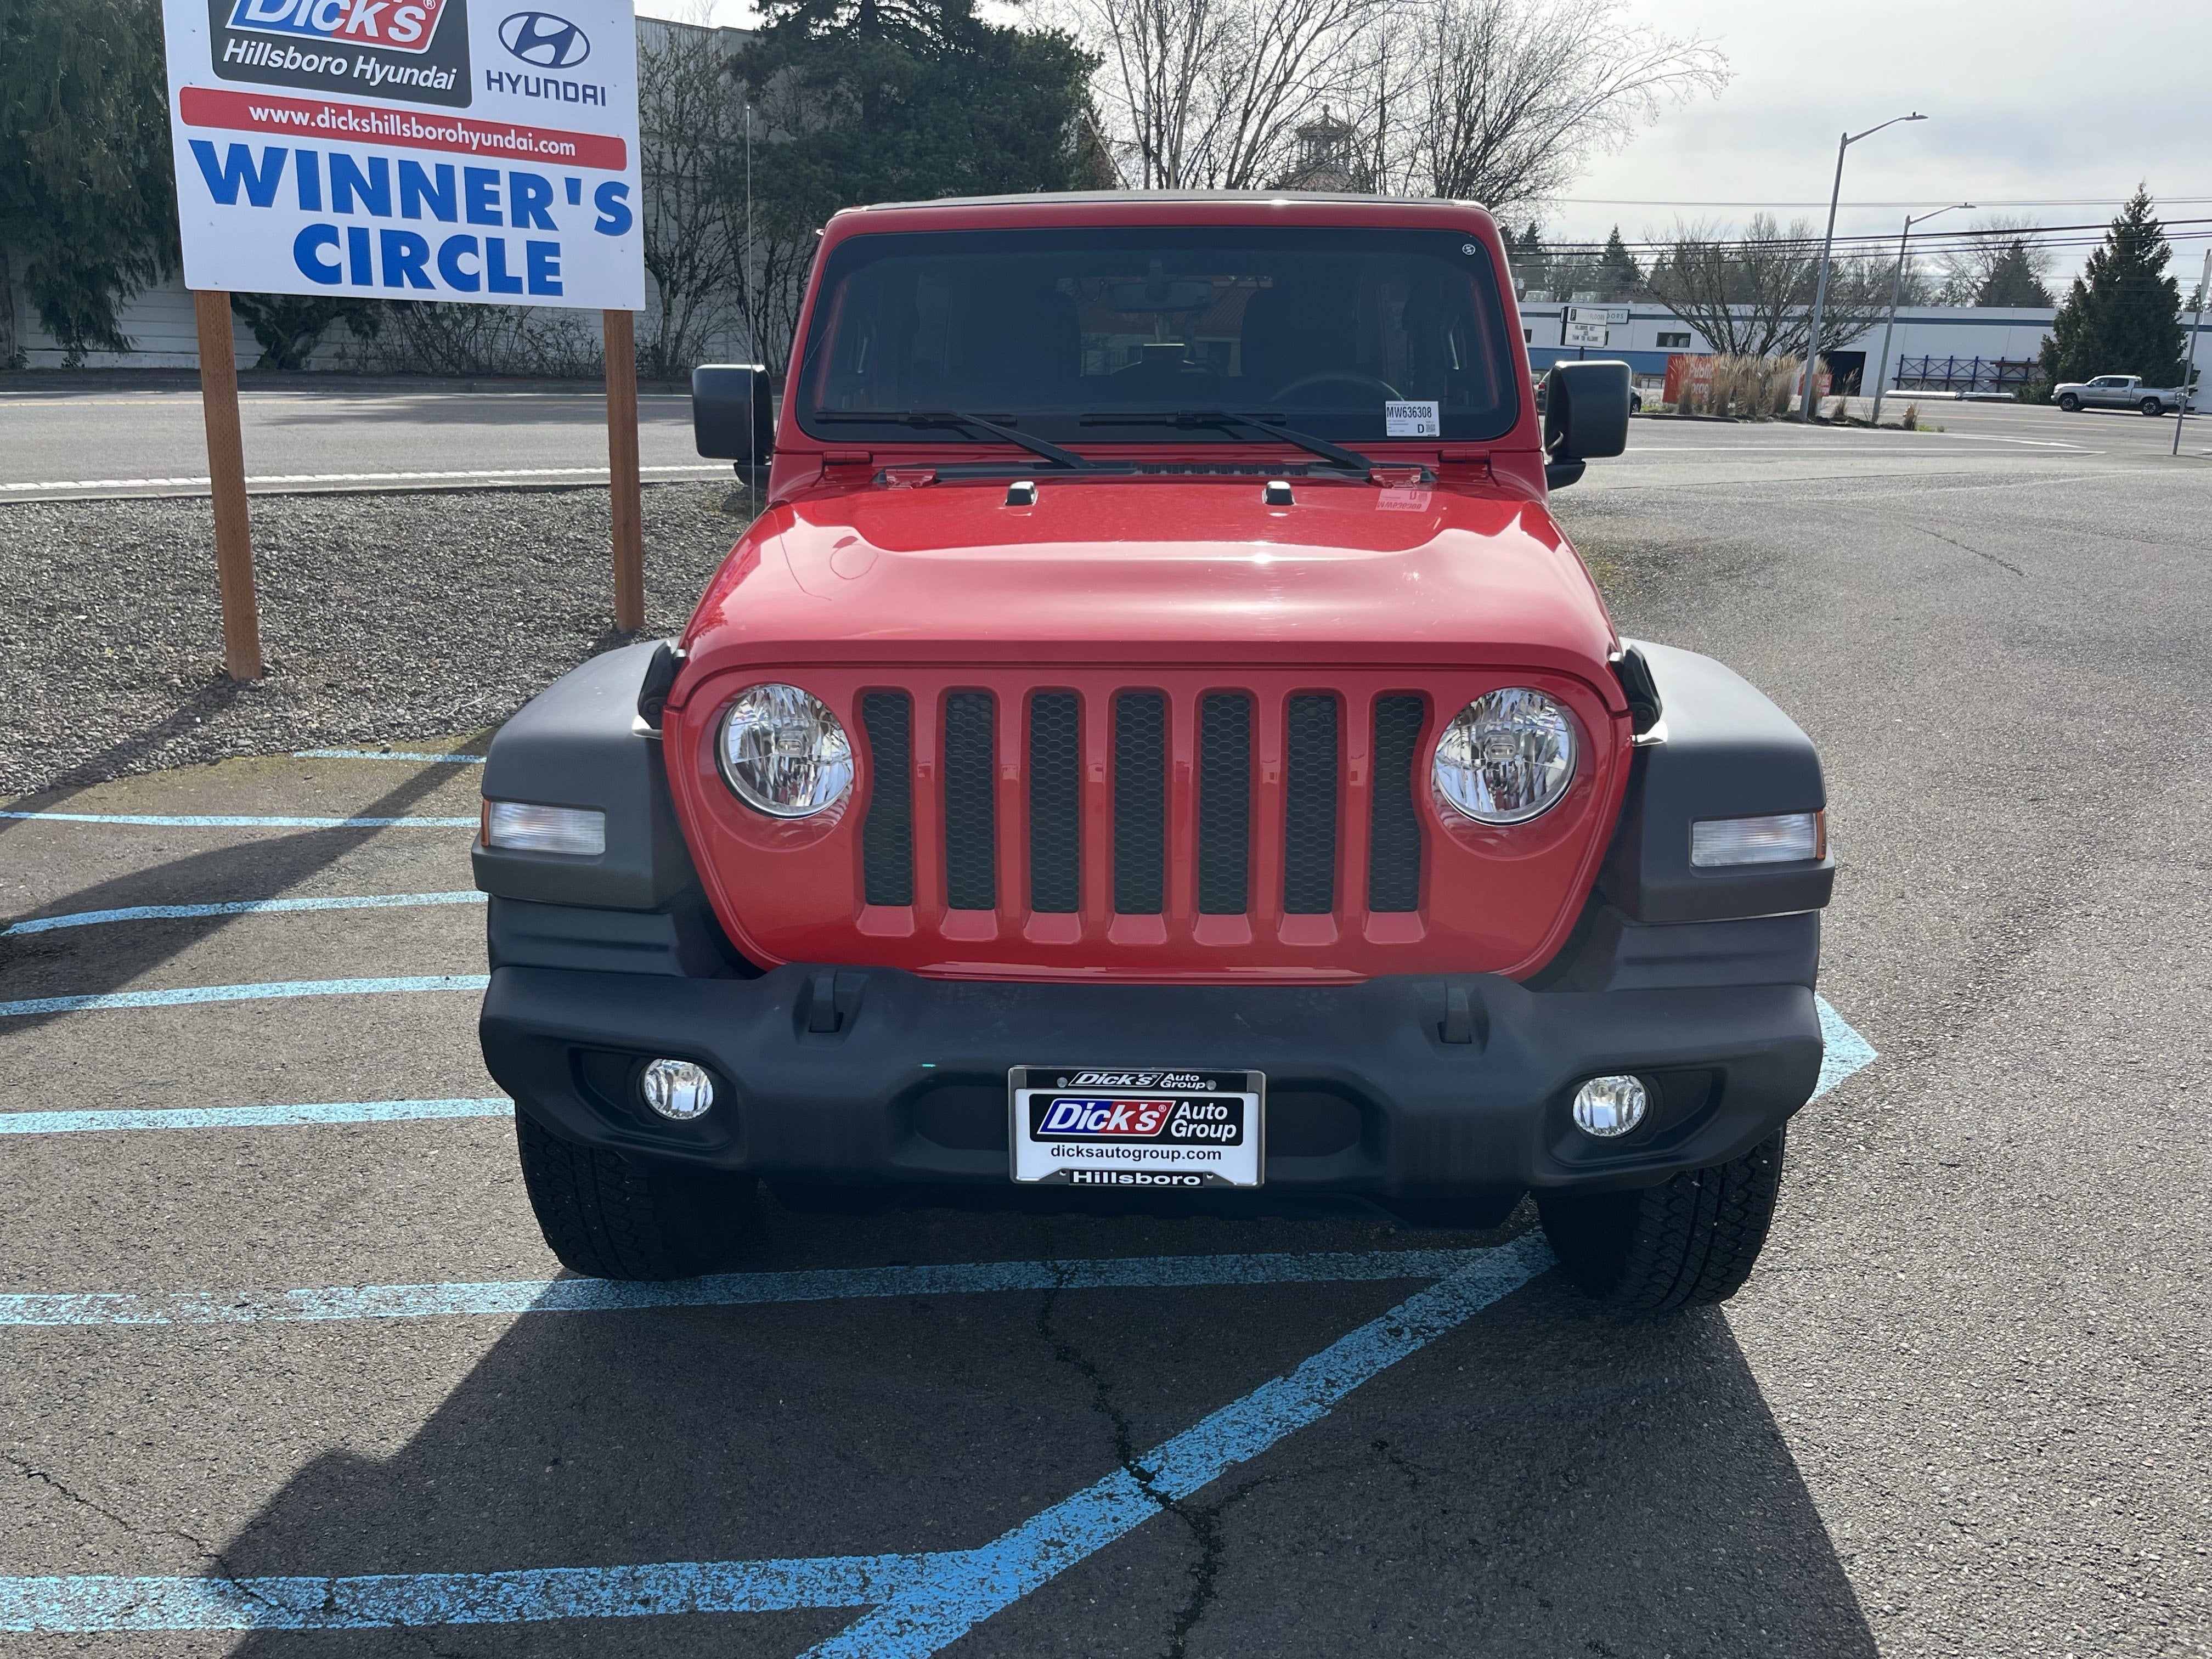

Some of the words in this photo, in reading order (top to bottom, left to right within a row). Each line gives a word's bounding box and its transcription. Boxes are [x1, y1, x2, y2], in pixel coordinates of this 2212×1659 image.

[245, 0, 426, 42] Dicks
[223, 38, 347, 75] Hillsboro
[353, 55, 458, 90] Hyundai
[486, 70, 606, 106] HYUNDAI
[249, 106, 575, 156] www.dickshillsborohyundai.com
[189, 140, 633, 236] WINNER'S
[294, 224, 564, 296] CIRCLE
[1386, 406, 1432, 418] MW636308
[1417, 424, 1424, 433] D
[1075, 1073, 1153, 1085] Dick's
[1164, 1073, 1200, 1082] Auto
[1160, 1080, 1206, 1090] Group
[1047, 1102, 1159, 1131] Dick's
[1174, 1102, 1228, 1120] Auto
[1170, 1120, 1237, 1142] Group
[1050, 1145, 1222, 1162] dicksautogroup.com
[1073, 1171, 1201, 1186] Hillsboro
